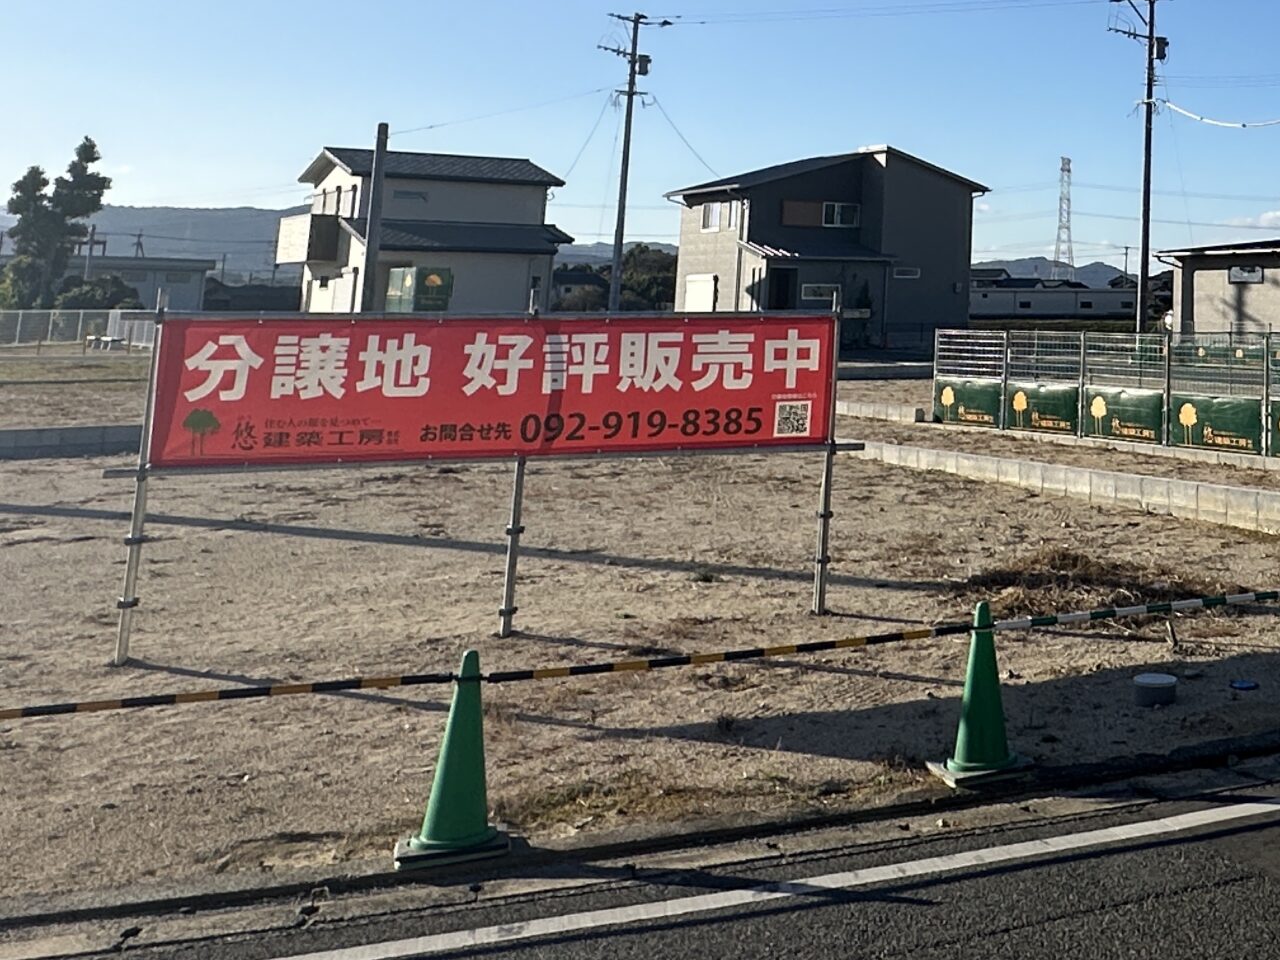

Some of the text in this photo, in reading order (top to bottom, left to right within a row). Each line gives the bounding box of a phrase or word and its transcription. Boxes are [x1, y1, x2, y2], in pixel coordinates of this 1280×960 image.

[184, 329, 820, 402] 分譲地 好評販売中
[231, 421, 258, 451] 悠
[263, 428, 384, 448] 建築工房
[420, 422, 512, 442] お問合せ先
[519, 407, 764, 444] 092-919-8385
